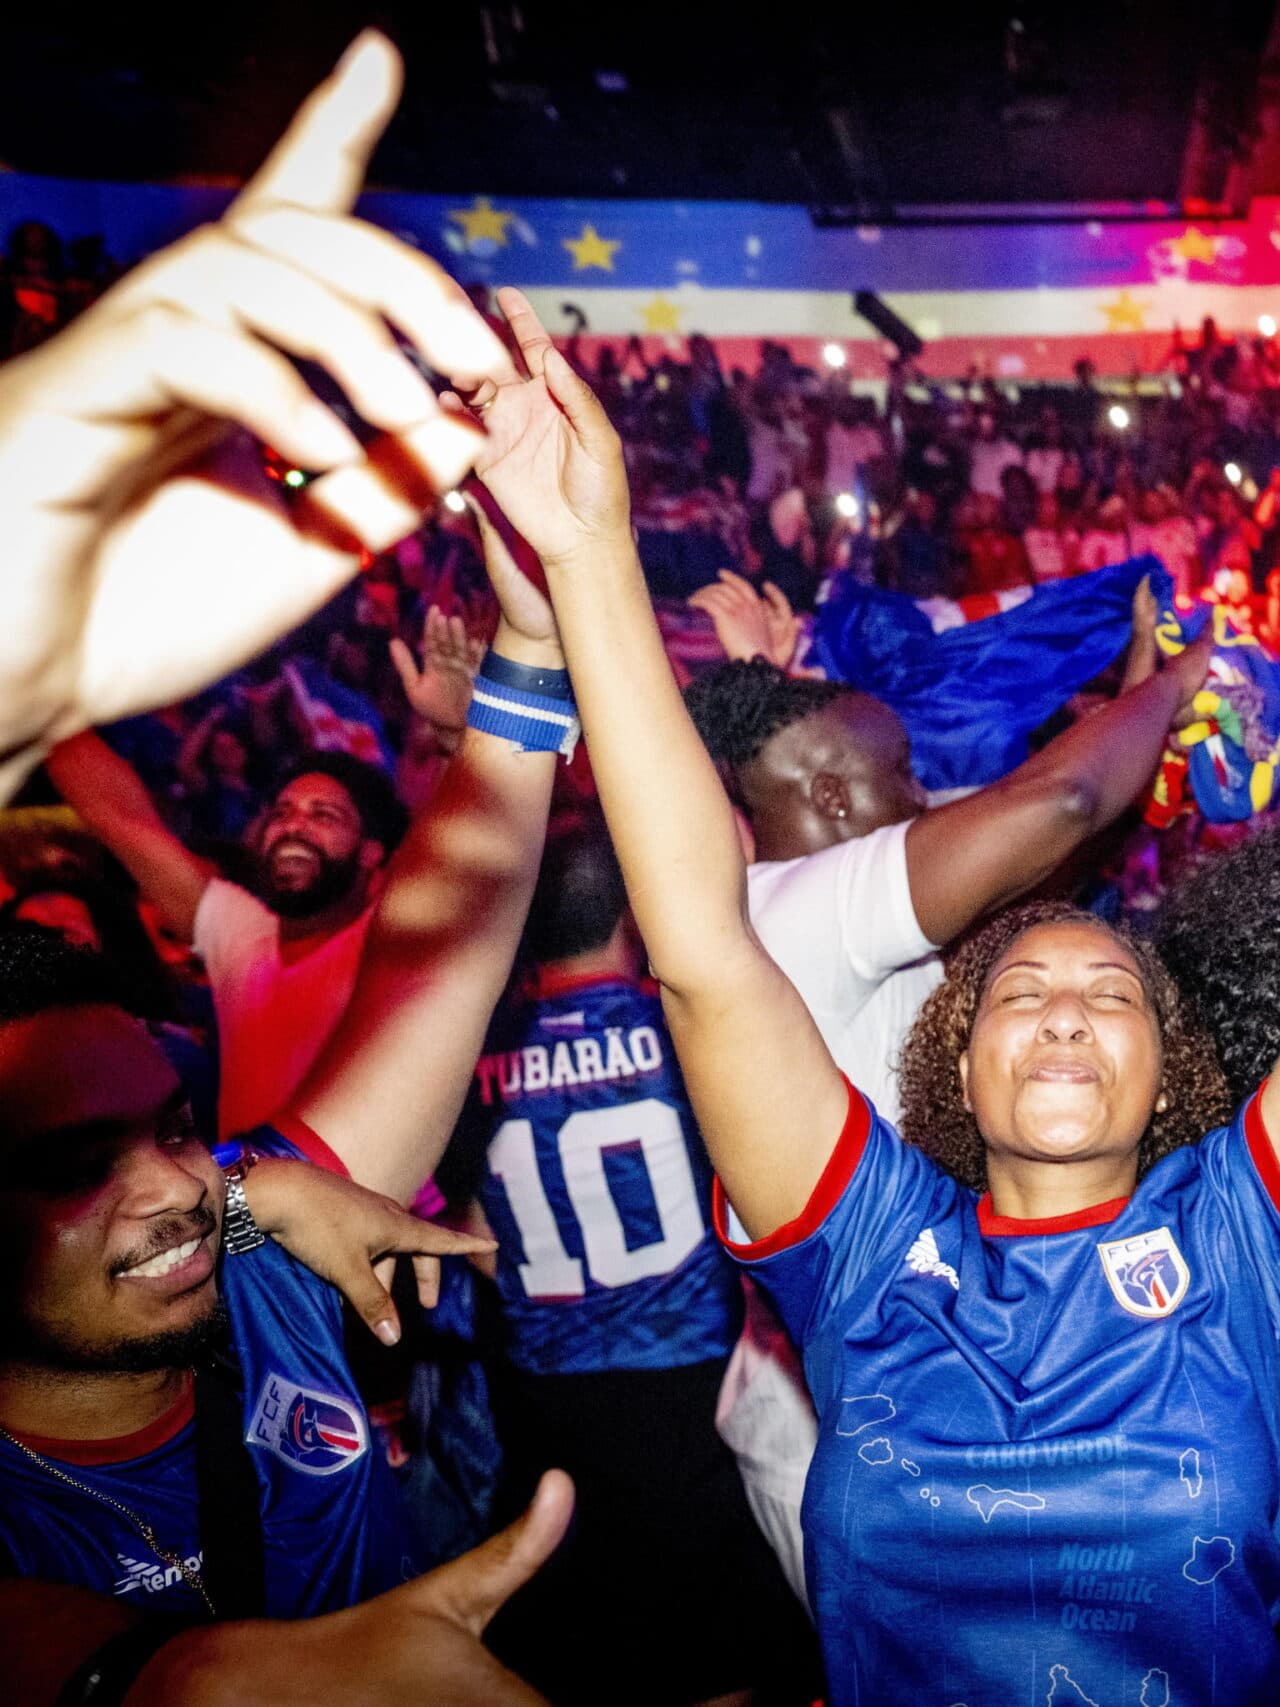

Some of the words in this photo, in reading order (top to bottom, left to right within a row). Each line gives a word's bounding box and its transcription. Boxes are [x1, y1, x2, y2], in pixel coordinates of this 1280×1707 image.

[473, 1025, 663, 1104] TUBARÃO
[486, 1098, 705, 1303] 10
[256, 1380, 282, 1443] FCF
[1057, 1542, 1135, 1572] North
[1059, 1573, 1158, 1603] Atlantic
[1060, 1602, 1137, 1632] Ocean
